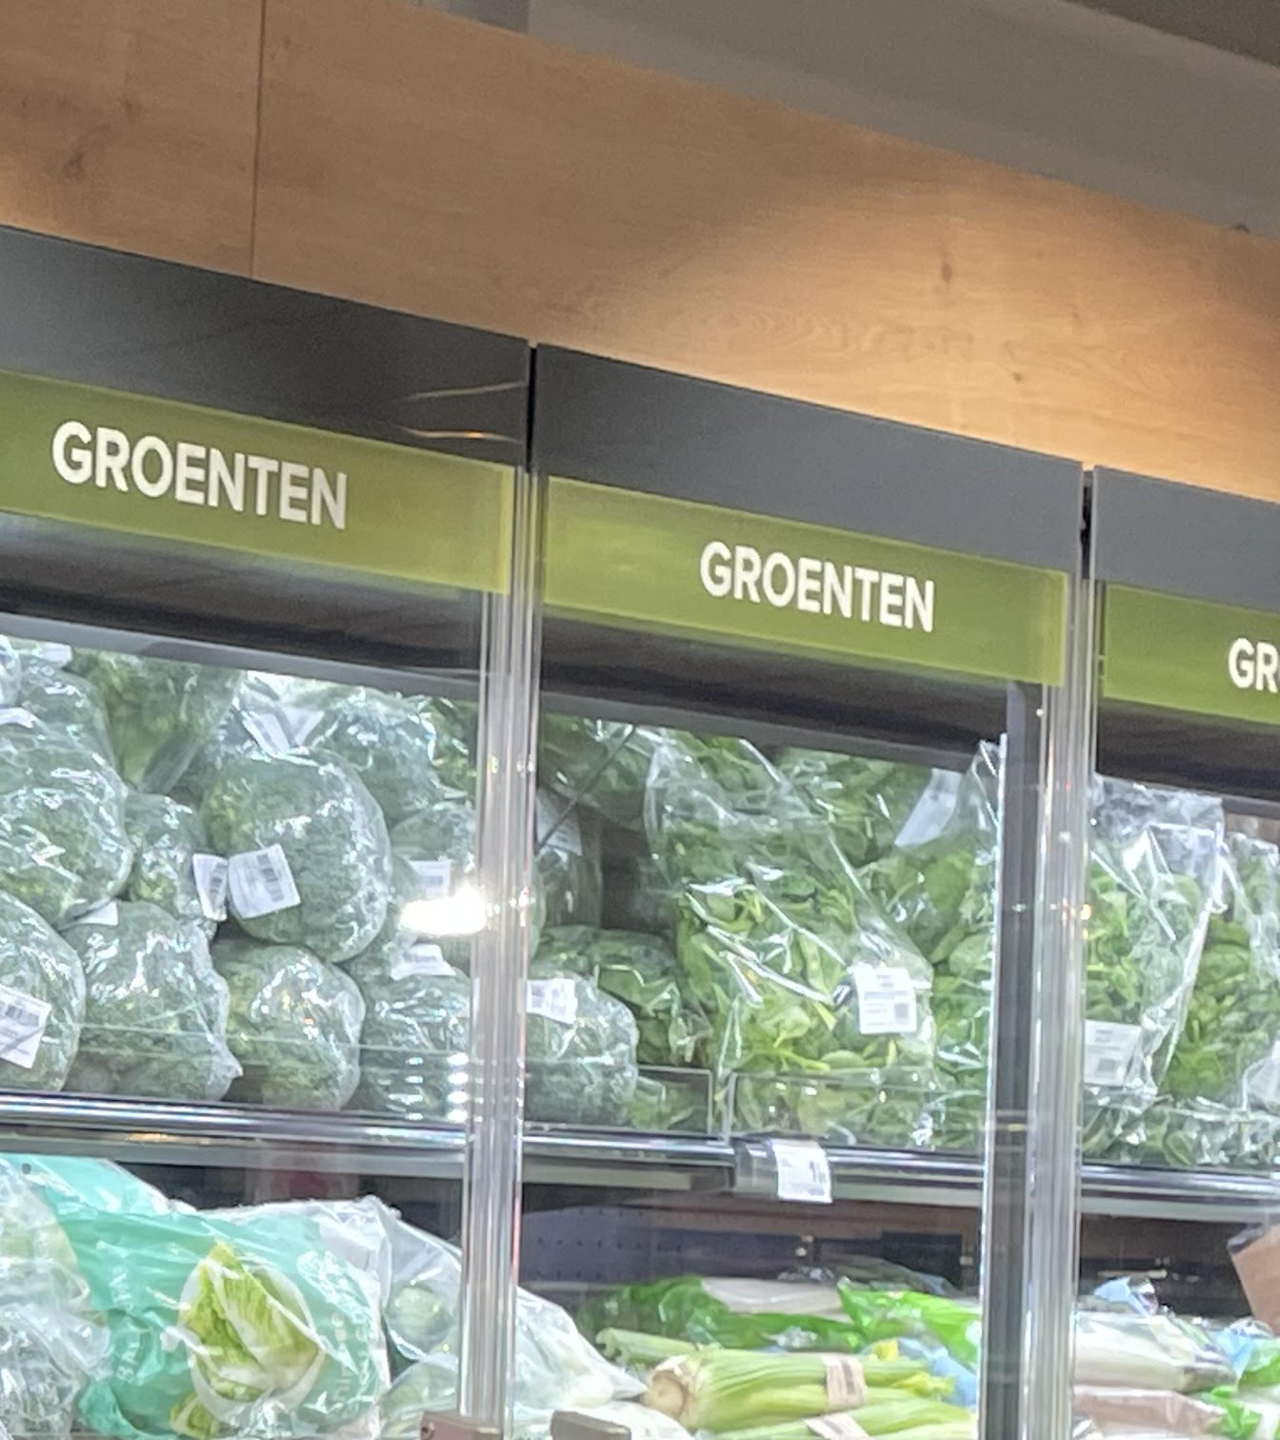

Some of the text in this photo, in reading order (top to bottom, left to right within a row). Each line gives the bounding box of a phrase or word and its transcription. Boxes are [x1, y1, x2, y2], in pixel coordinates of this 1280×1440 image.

[52, 420, 348, 530] GROENTEN
[699, 540, 936, 634] GROENTEN
[1227, 637, 1280, 694] GR
